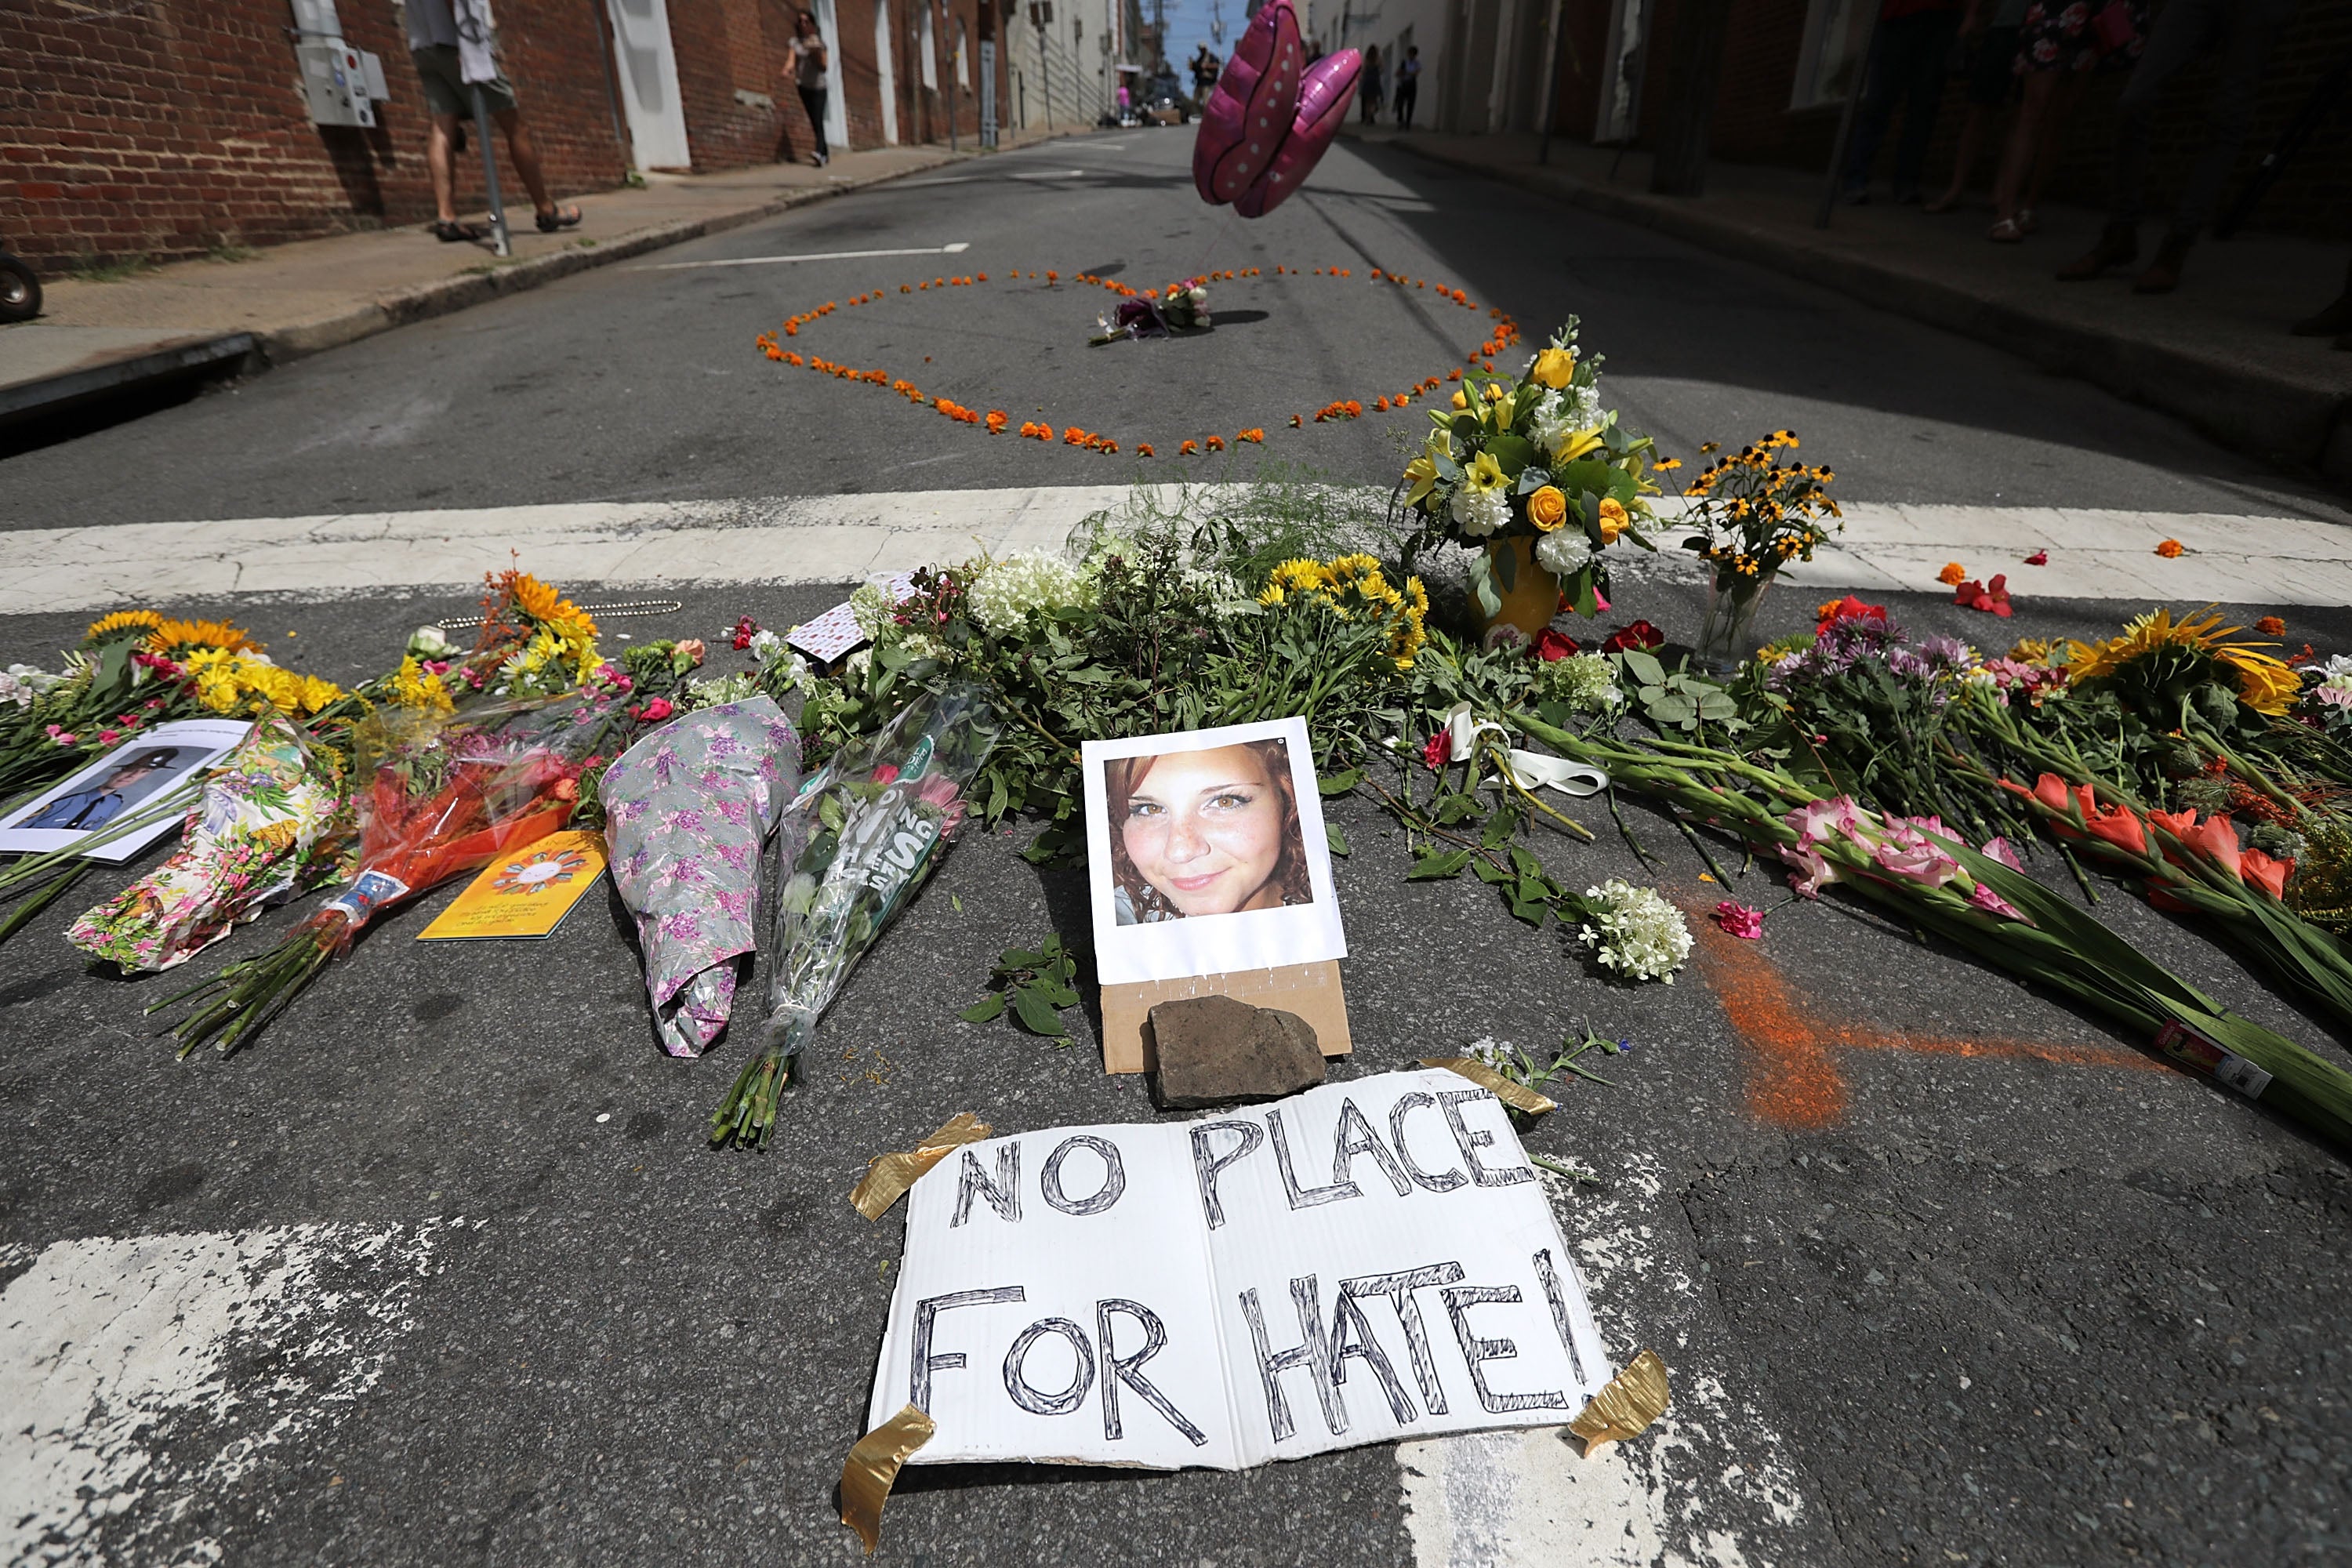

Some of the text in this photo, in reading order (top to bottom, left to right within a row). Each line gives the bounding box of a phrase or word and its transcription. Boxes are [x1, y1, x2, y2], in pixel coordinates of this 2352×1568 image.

[950, 1087, 1536, 1231] NO PLACE
[910, 1249, 1593, 1446] FOR HATE!
